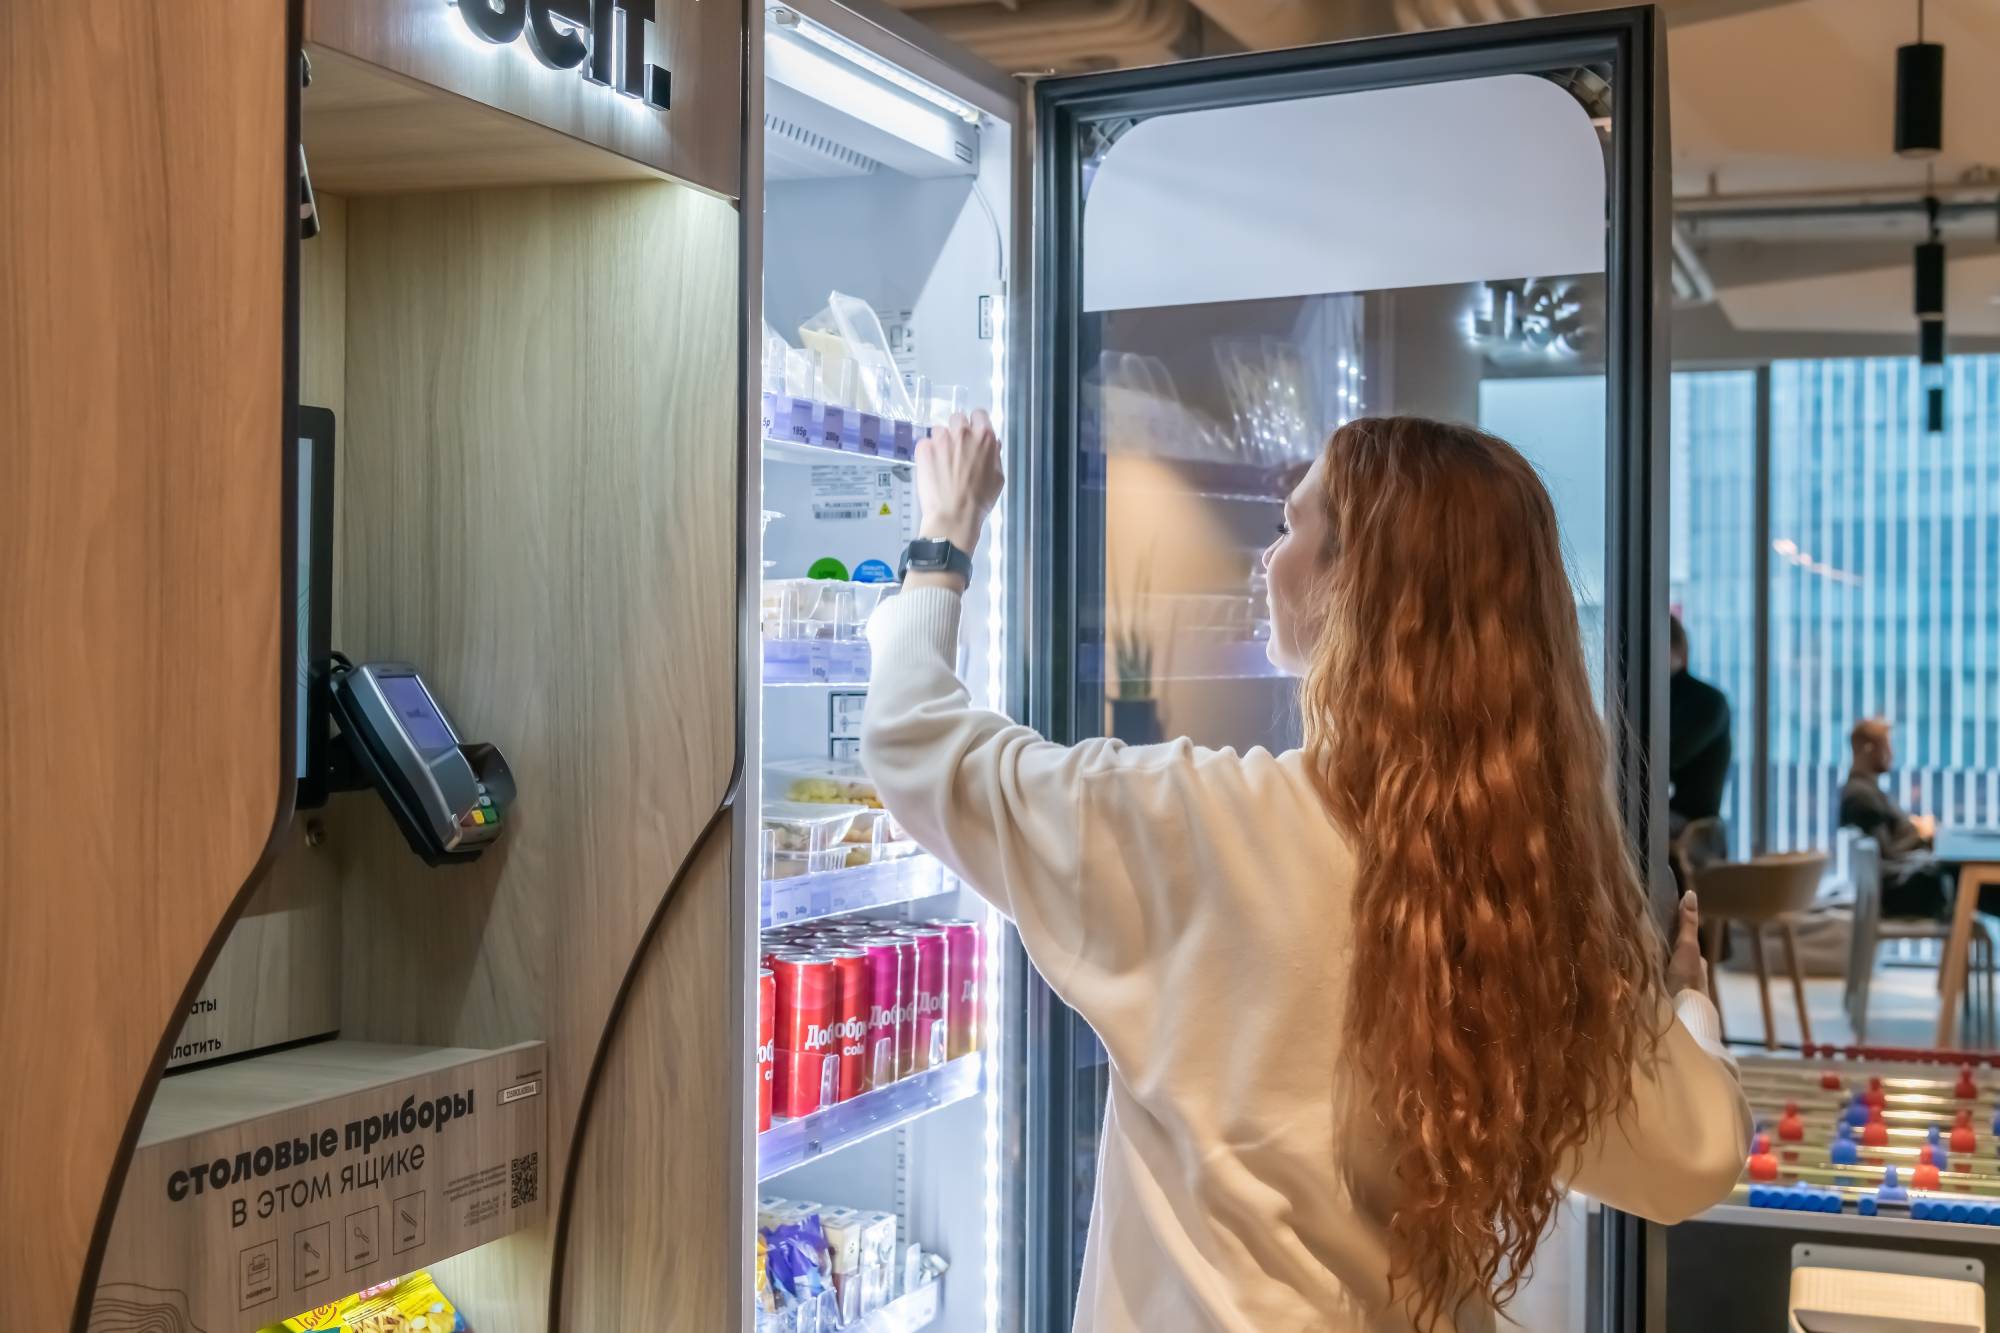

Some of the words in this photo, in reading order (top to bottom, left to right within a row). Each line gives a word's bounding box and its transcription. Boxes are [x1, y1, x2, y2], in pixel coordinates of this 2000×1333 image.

[190, 998, 217, 1015] аты
[171, 1039, 222, 1060] латить
[167, 1127, 339, 1202] столовые
[345, 1089, 475, 1154] приборы
[232, 1199, 248, 1229] в
[257, 1172, 332, 1219] этом
[340, 1144, 426, 1194] ящике
